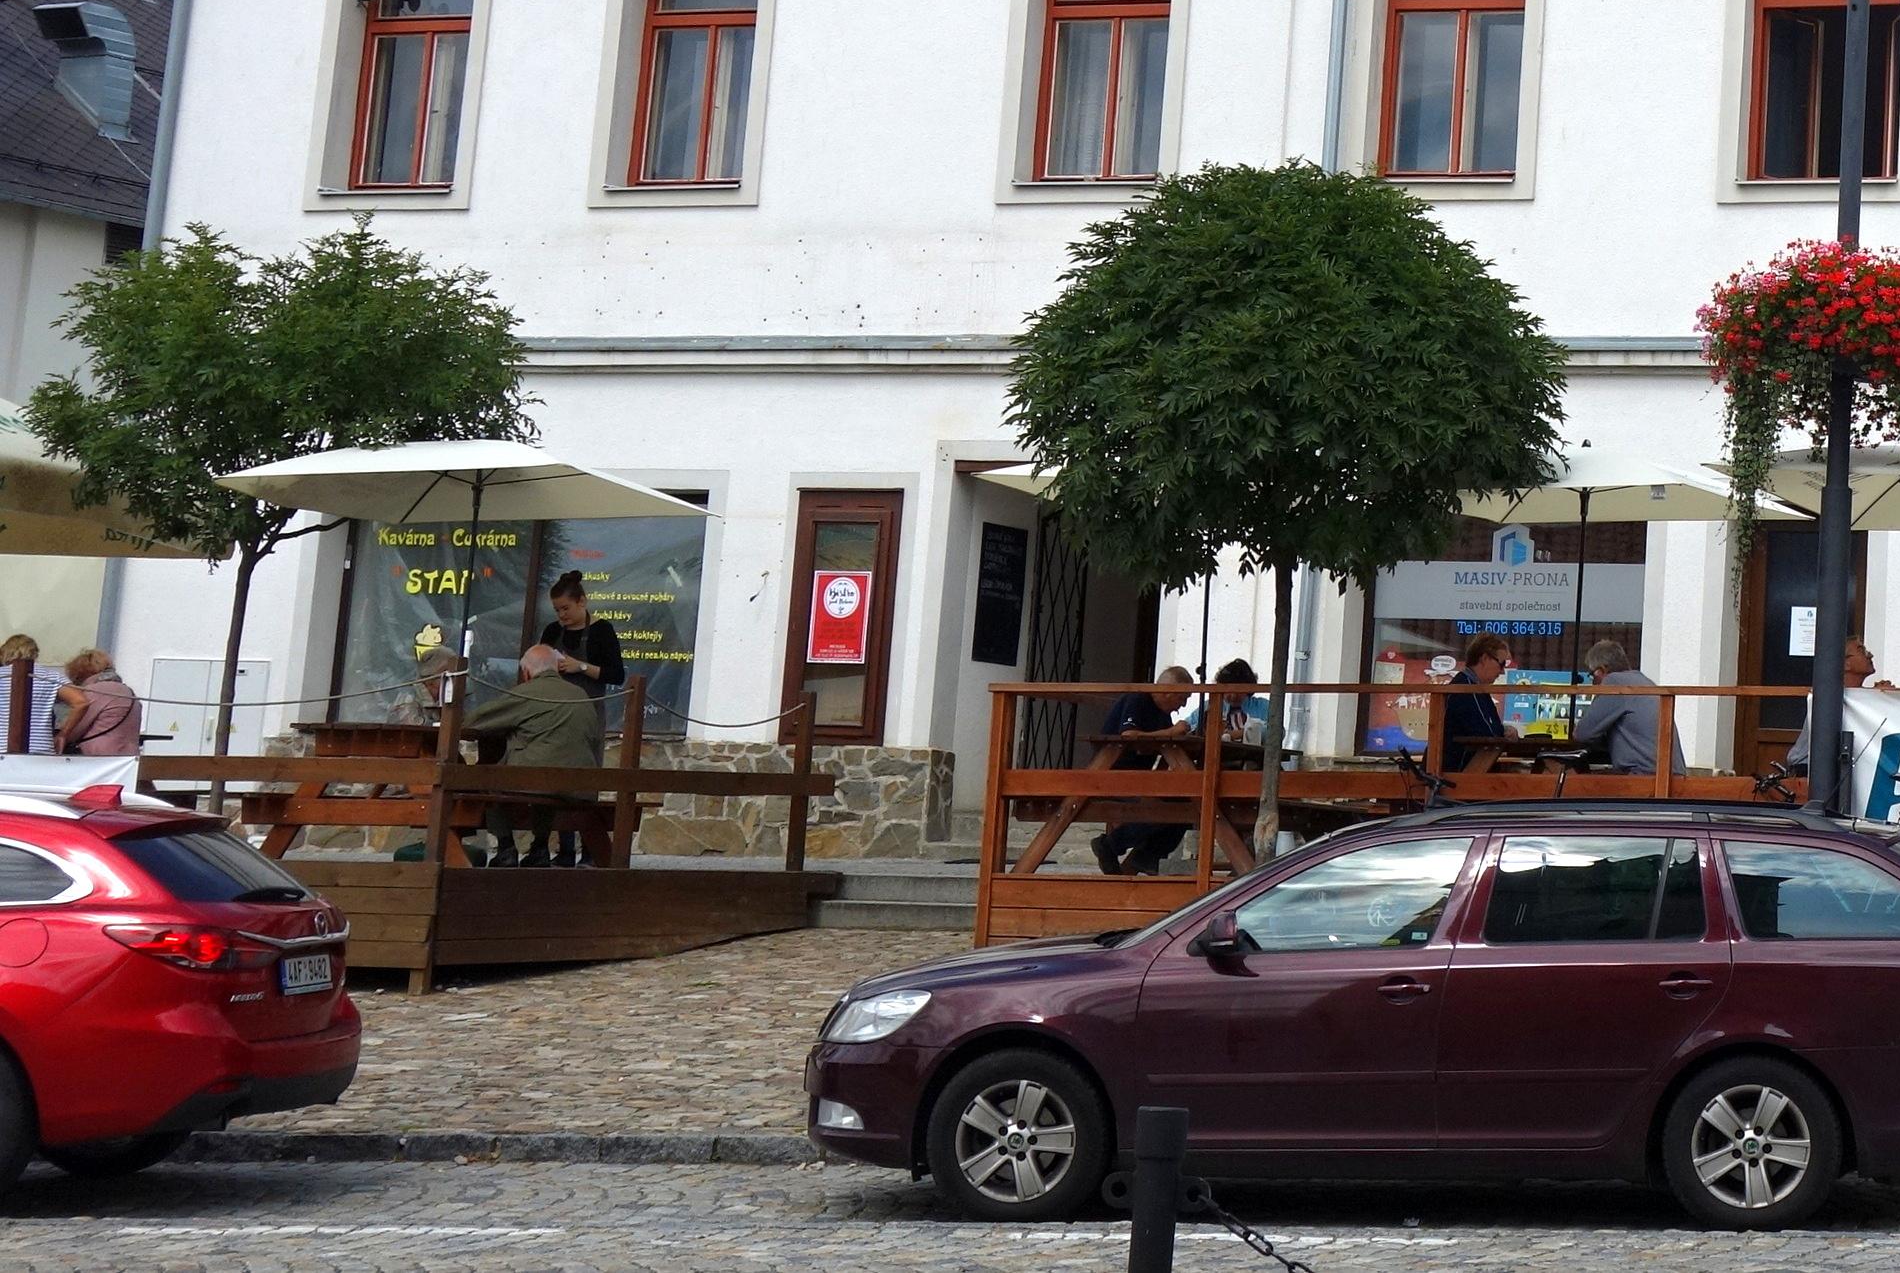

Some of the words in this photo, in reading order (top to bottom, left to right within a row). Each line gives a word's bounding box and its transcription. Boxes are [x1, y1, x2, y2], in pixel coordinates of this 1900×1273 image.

[378, 527, 435, 548] Kavárna
[582, 571, 611, 582] ákusky
[1454, 571, 1569, 587] MASIV-PRONA
[1459, 600, 1503, 611] stavební
[1505, 601, 1561, 613] společnost
[1457, 621, 1481, 635] Tel:
[1485, 621, 1508, 634] 606
[1511, 622, 1535, 635] 364
[1538, 622, 1562, 635] 315
[633, 629, 664, 643] koktejly
